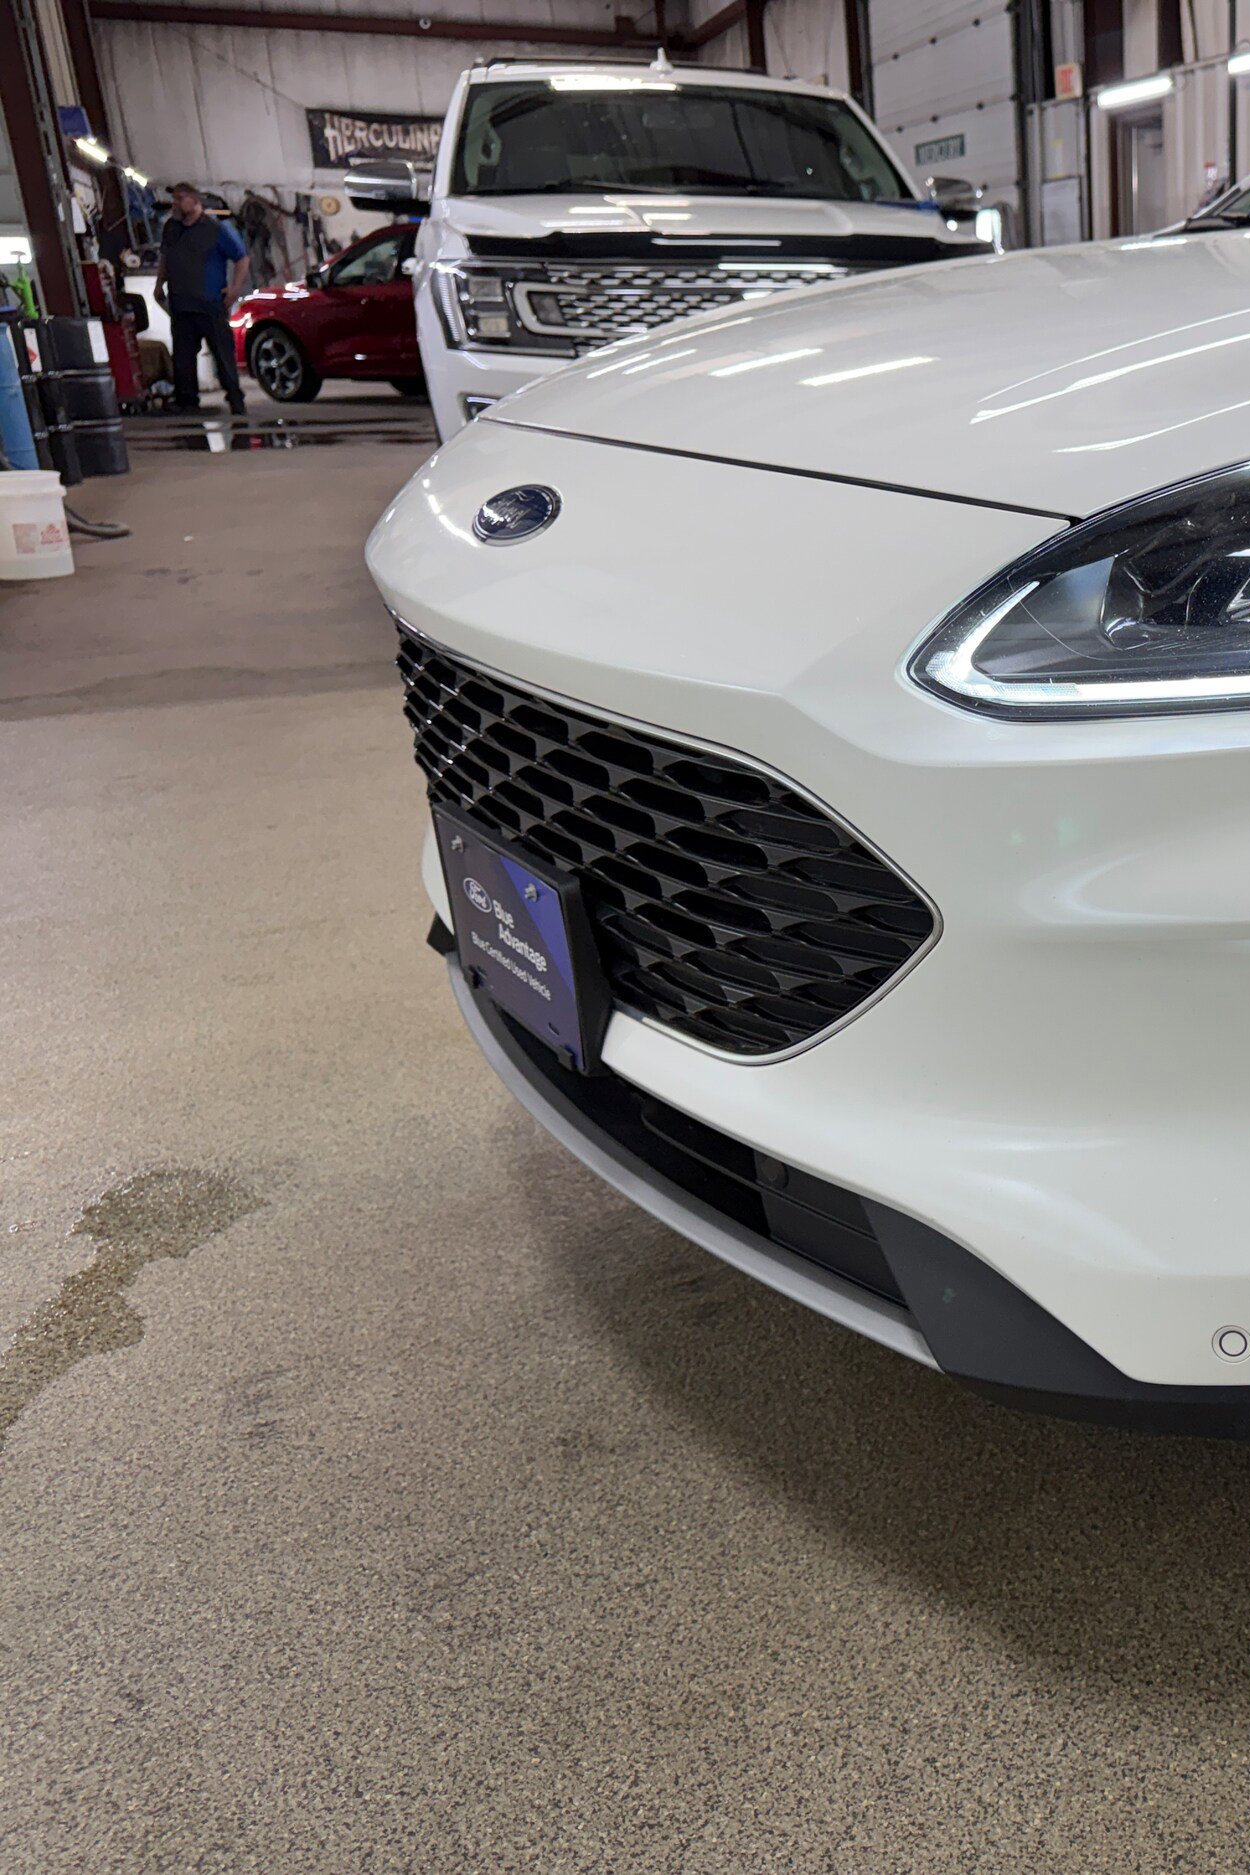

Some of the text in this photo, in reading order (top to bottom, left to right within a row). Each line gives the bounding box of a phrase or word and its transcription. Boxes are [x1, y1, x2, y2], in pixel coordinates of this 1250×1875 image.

[468, 881, 488, 908] Ford
[493, 899, 515, 929] Blue
[498, 923, 547, 972] Advantage
[485, 942, 512, 970] Certified
[511, 962, 528, 983] Used
[528, 974, 551, 1001] Vehicle
